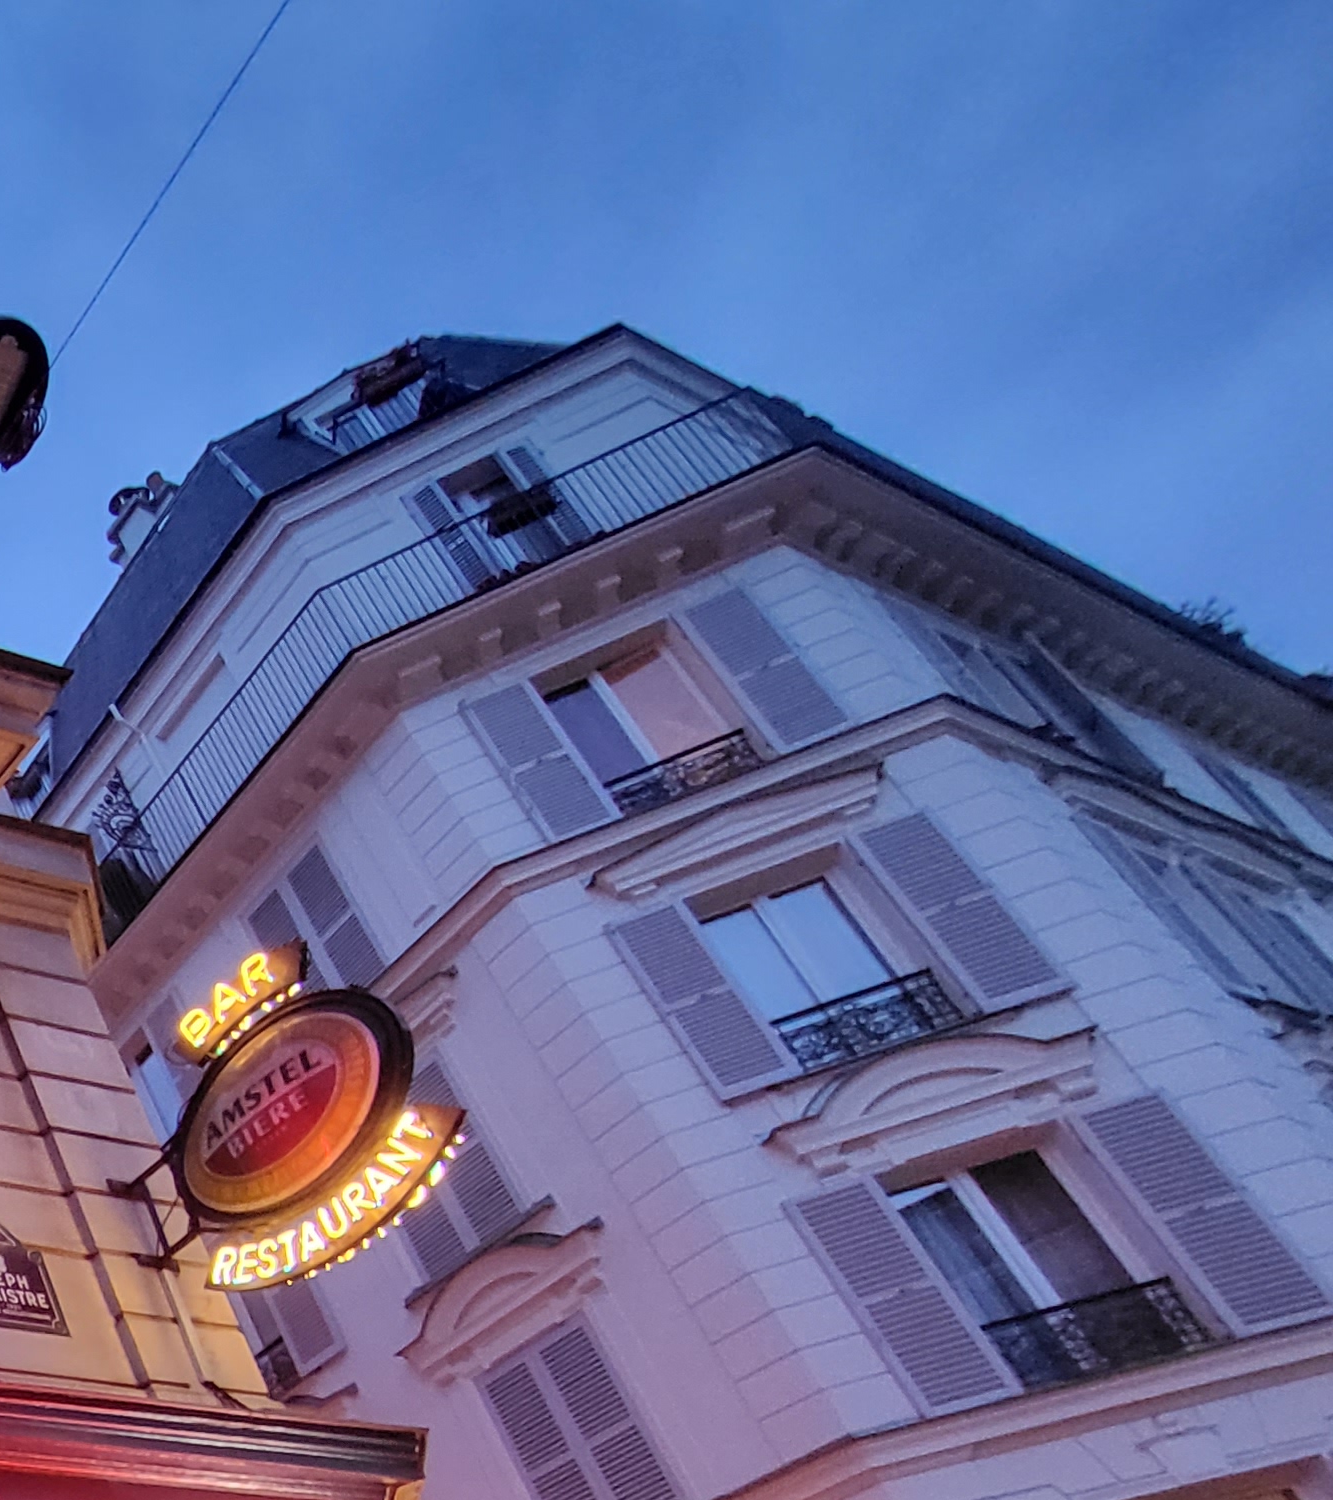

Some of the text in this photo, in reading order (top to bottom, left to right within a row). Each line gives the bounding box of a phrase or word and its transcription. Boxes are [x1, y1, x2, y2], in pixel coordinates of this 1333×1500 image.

[179, 952, 273, 1048] BAR
[204, 1049, 322, 1150] AMSTEL
[227, 1088, 306, 1159] BIERE
[211, 1111, 434, 1285] RESTAURANT
